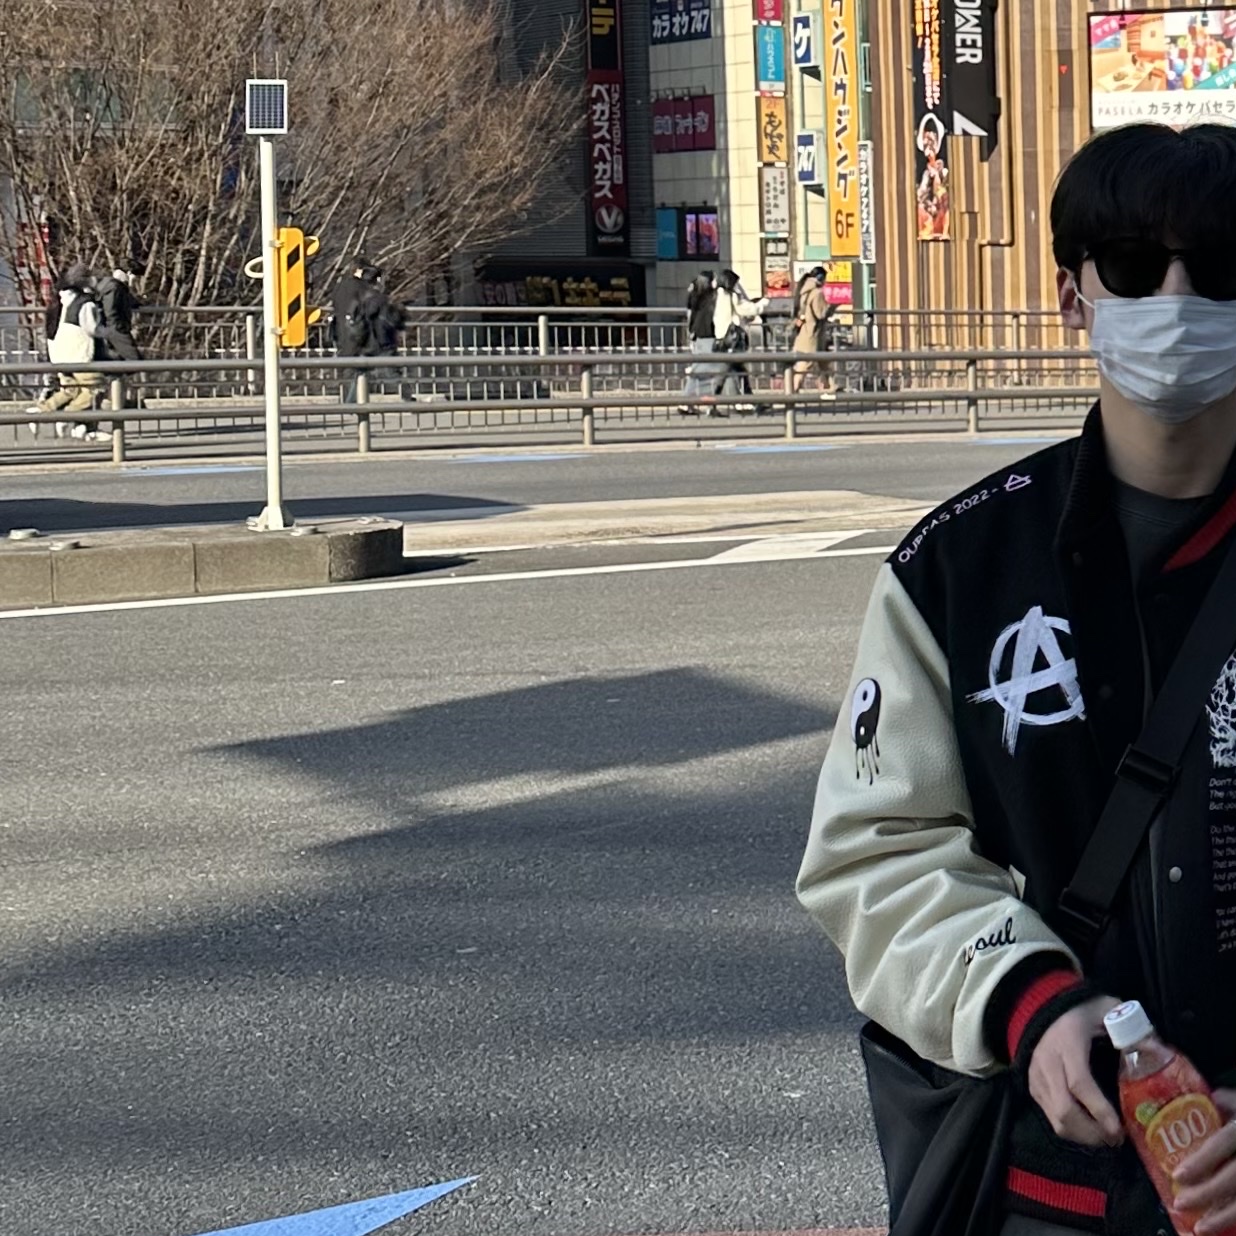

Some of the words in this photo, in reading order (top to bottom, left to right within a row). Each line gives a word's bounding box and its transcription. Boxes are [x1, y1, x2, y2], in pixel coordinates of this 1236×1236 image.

[652, 9, 710, 38] カラオケ747
[592, 84, 612, 199] ベガスベガス
[798, 146, 815, 171] 747
[835, 209, 855, 238] 6F
[1157, 1108, 1207, 1153] 100
